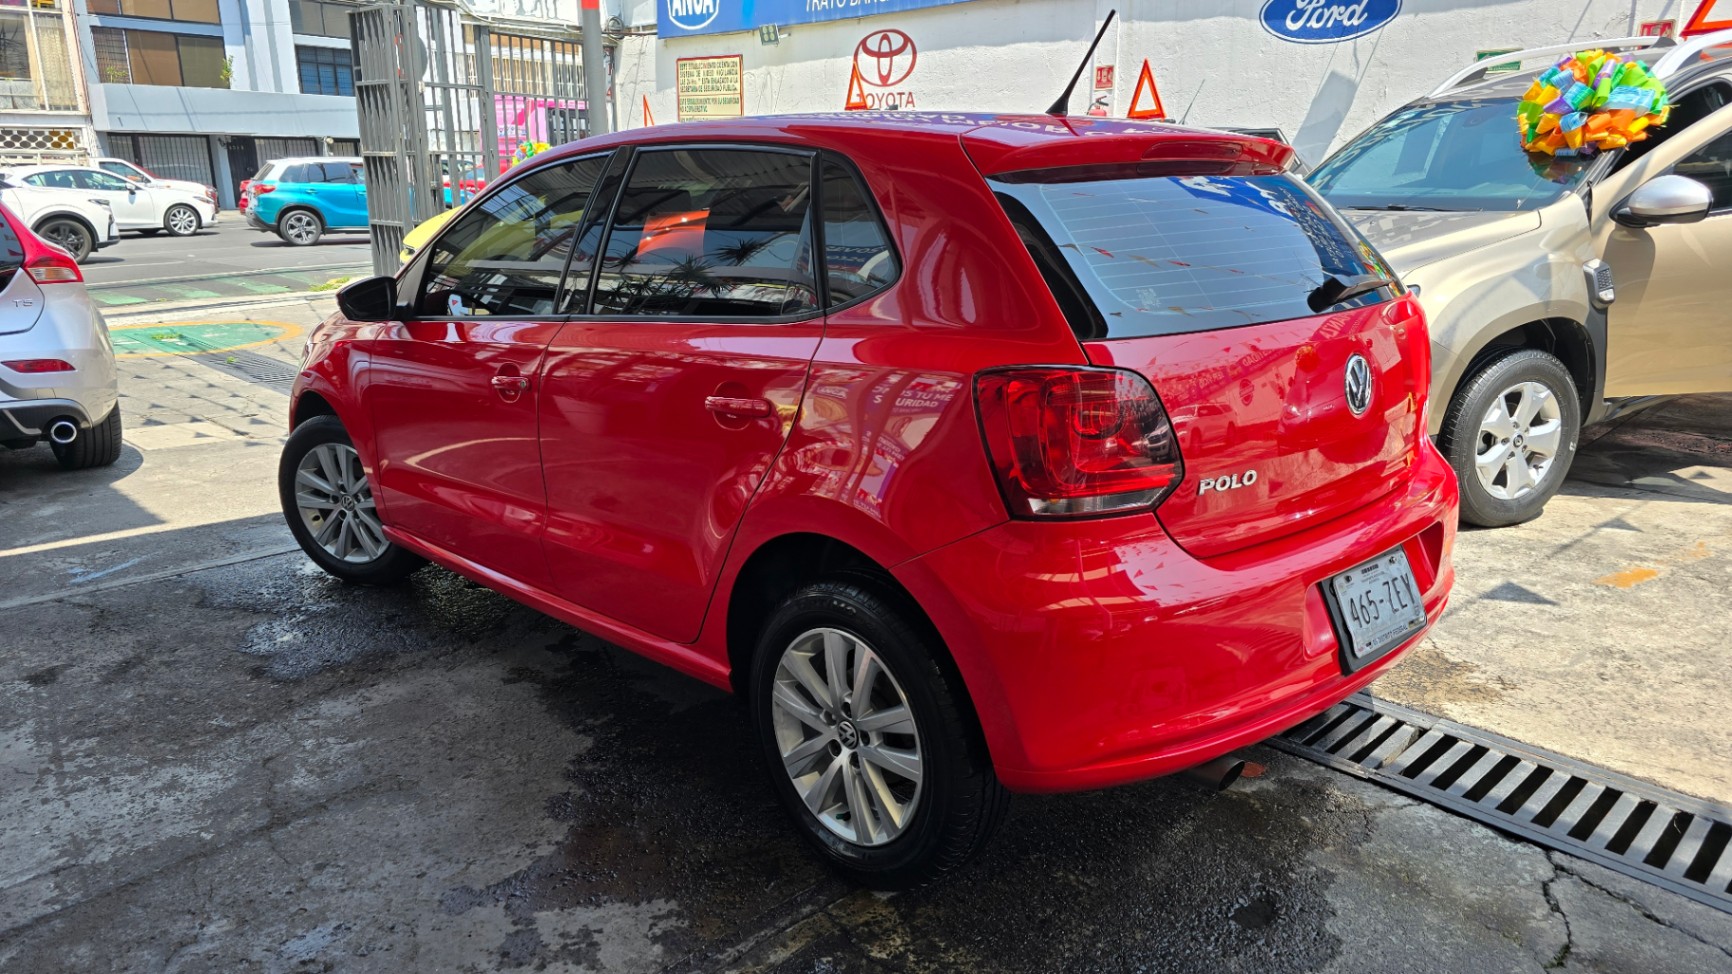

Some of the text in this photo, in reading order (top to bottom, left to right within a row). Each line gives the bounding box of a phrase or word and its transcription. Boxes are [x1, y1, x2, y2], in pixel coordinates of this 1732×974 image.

[1285, 0, 1368, 31] Ford
[1197, 469, 1258, 496] POLO
[1349, 572, 1415, 629] 465-ZEY
